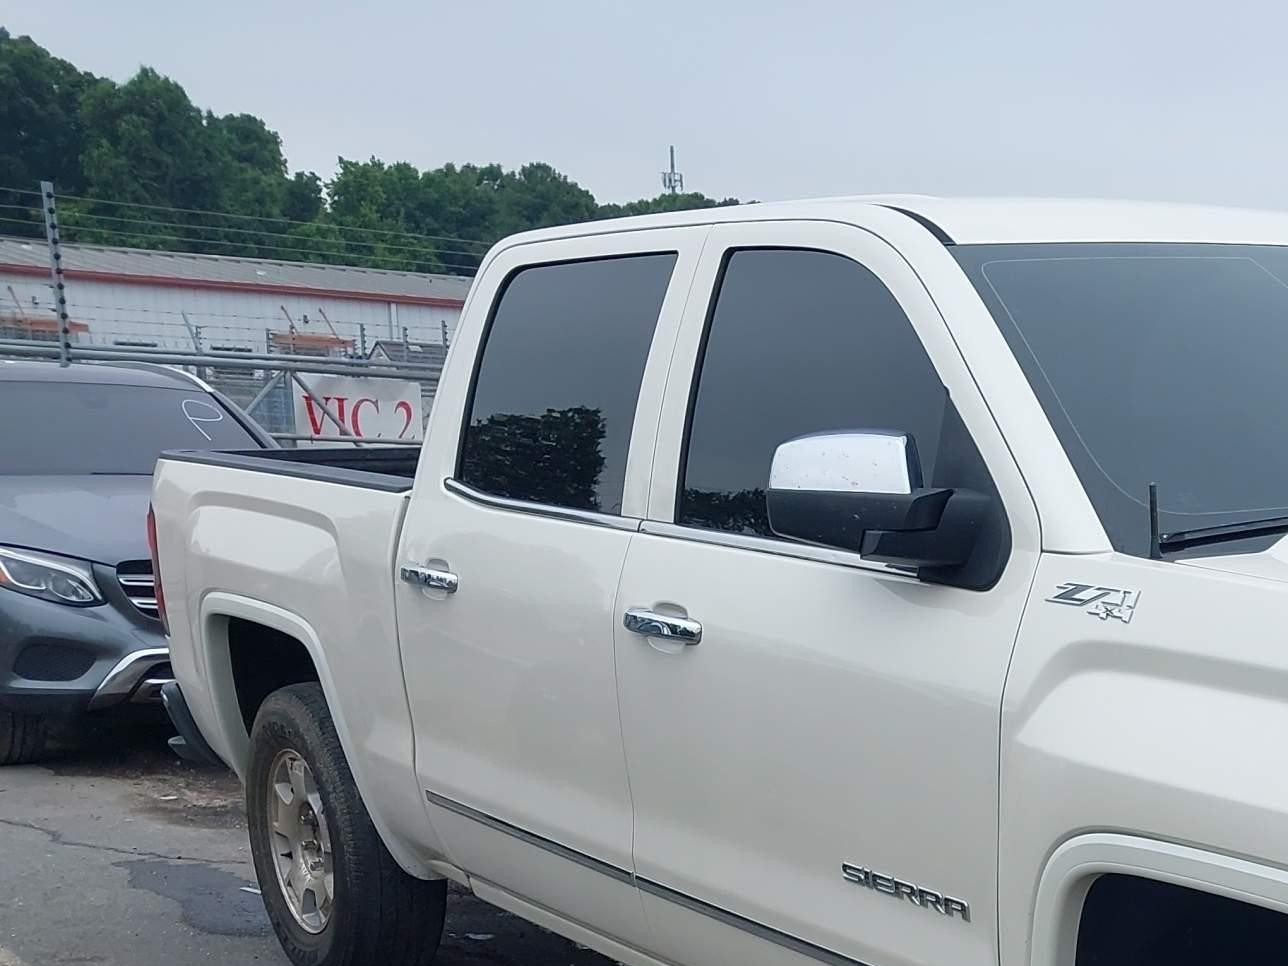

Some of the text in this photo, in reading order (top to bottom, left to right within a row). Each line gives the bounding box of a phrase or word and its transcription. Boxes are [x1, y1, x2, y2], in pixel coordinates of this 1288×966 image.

[302, 395, 416, 440] VIC 2
[1044, 582, 1141, 609] Z71
[841, 860, 971, 922] SIERRA
